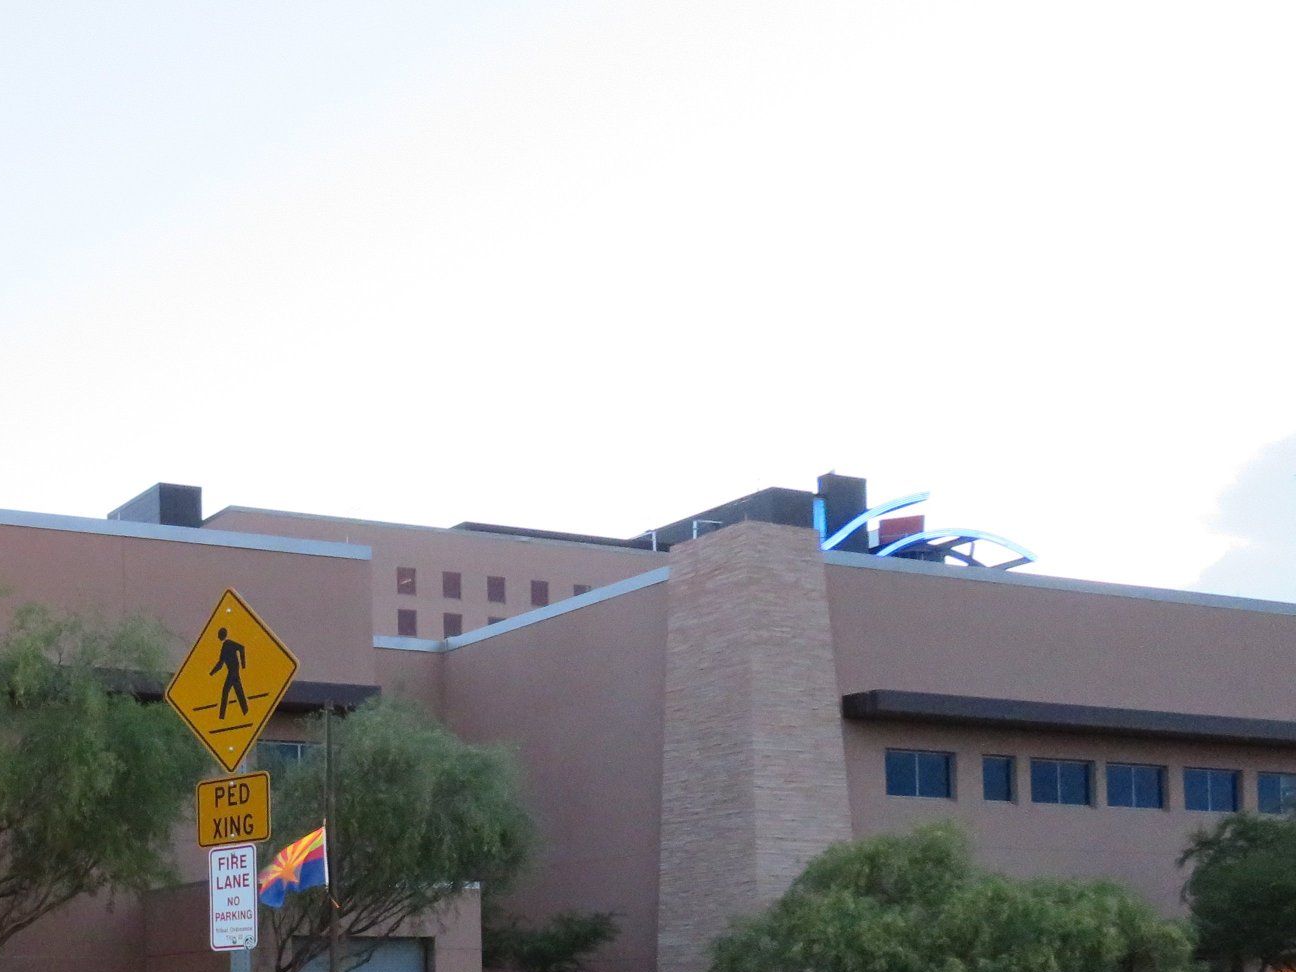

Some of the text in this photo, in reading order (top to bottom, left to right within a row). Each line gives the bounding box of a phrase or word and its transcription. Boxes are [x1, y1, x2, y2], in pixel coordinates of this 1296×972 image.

[215, 783, 251, 808] PED
[213, 814, 254, 839] XING
[218, 855, 248, 871] FIRE
[216, 873, 250, 890] LANE
[227, 896, 241, 907] NO
[215, 912, 253, 922] PARKING
